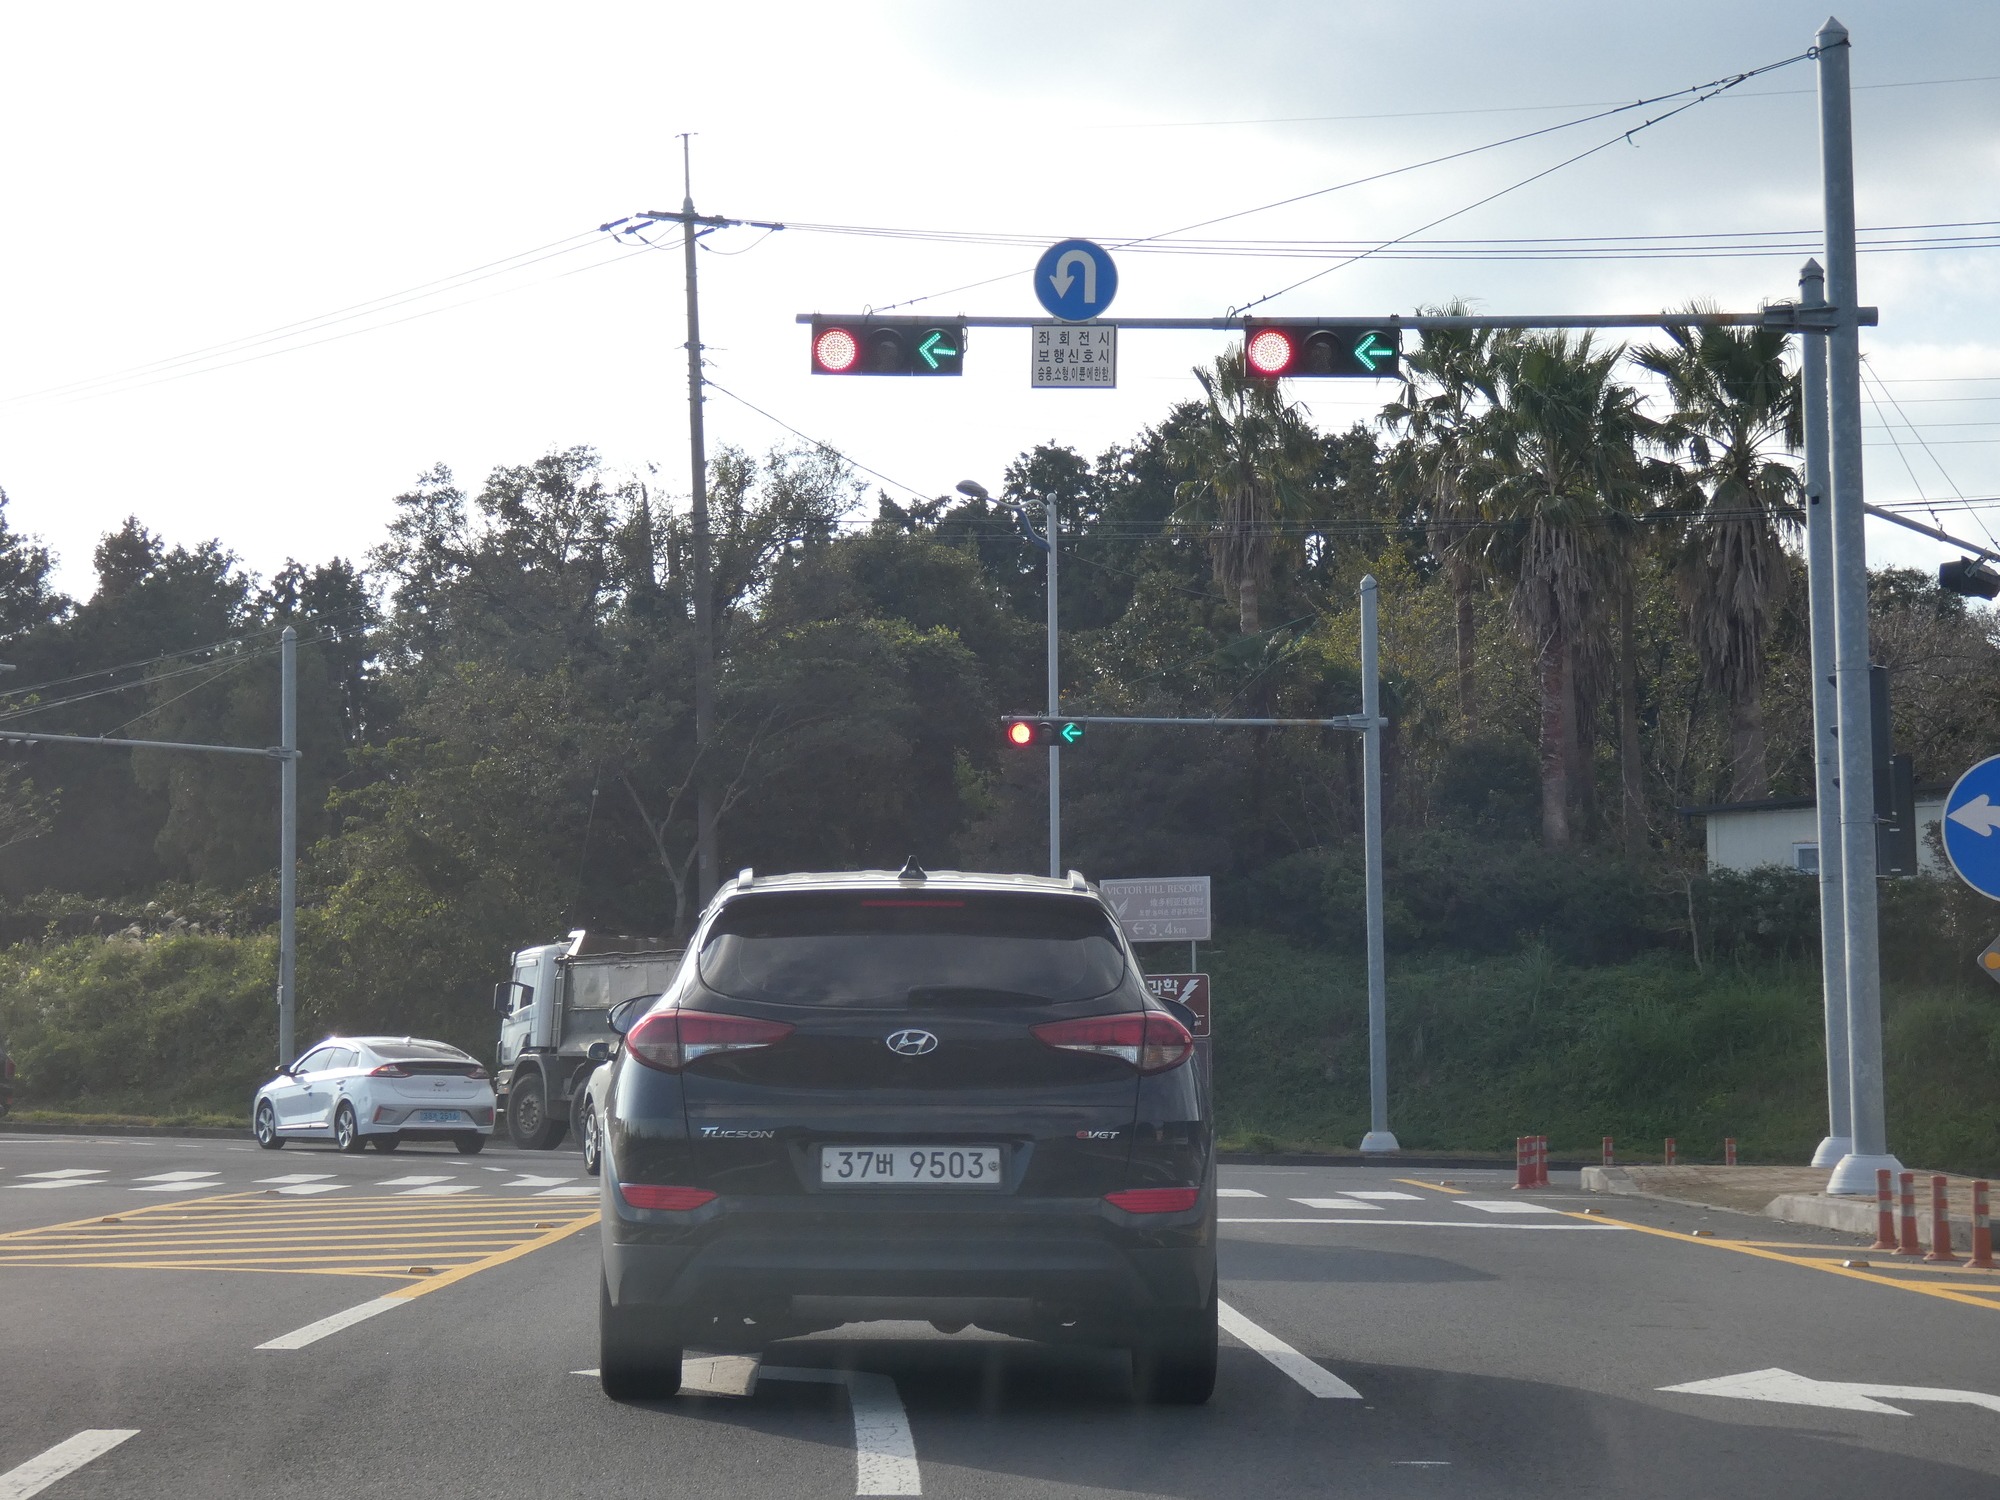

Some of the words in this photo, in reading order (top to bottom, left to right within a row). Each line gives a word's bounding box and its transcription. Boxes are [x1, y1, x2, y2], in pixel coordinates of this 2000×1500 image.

[1038, 348, 1110, 363] 보행신호시
[1106, 886, 1142, 895] VICTOR
[1144, 885, 1166, 894] HILL
[1167, 884, 1203, 893] RESORT
[700, 1126, 775, 1139] TUCSON
[837, 1151, 894, 1178] 37버
[910, 1151, 984, 1179] 9503
